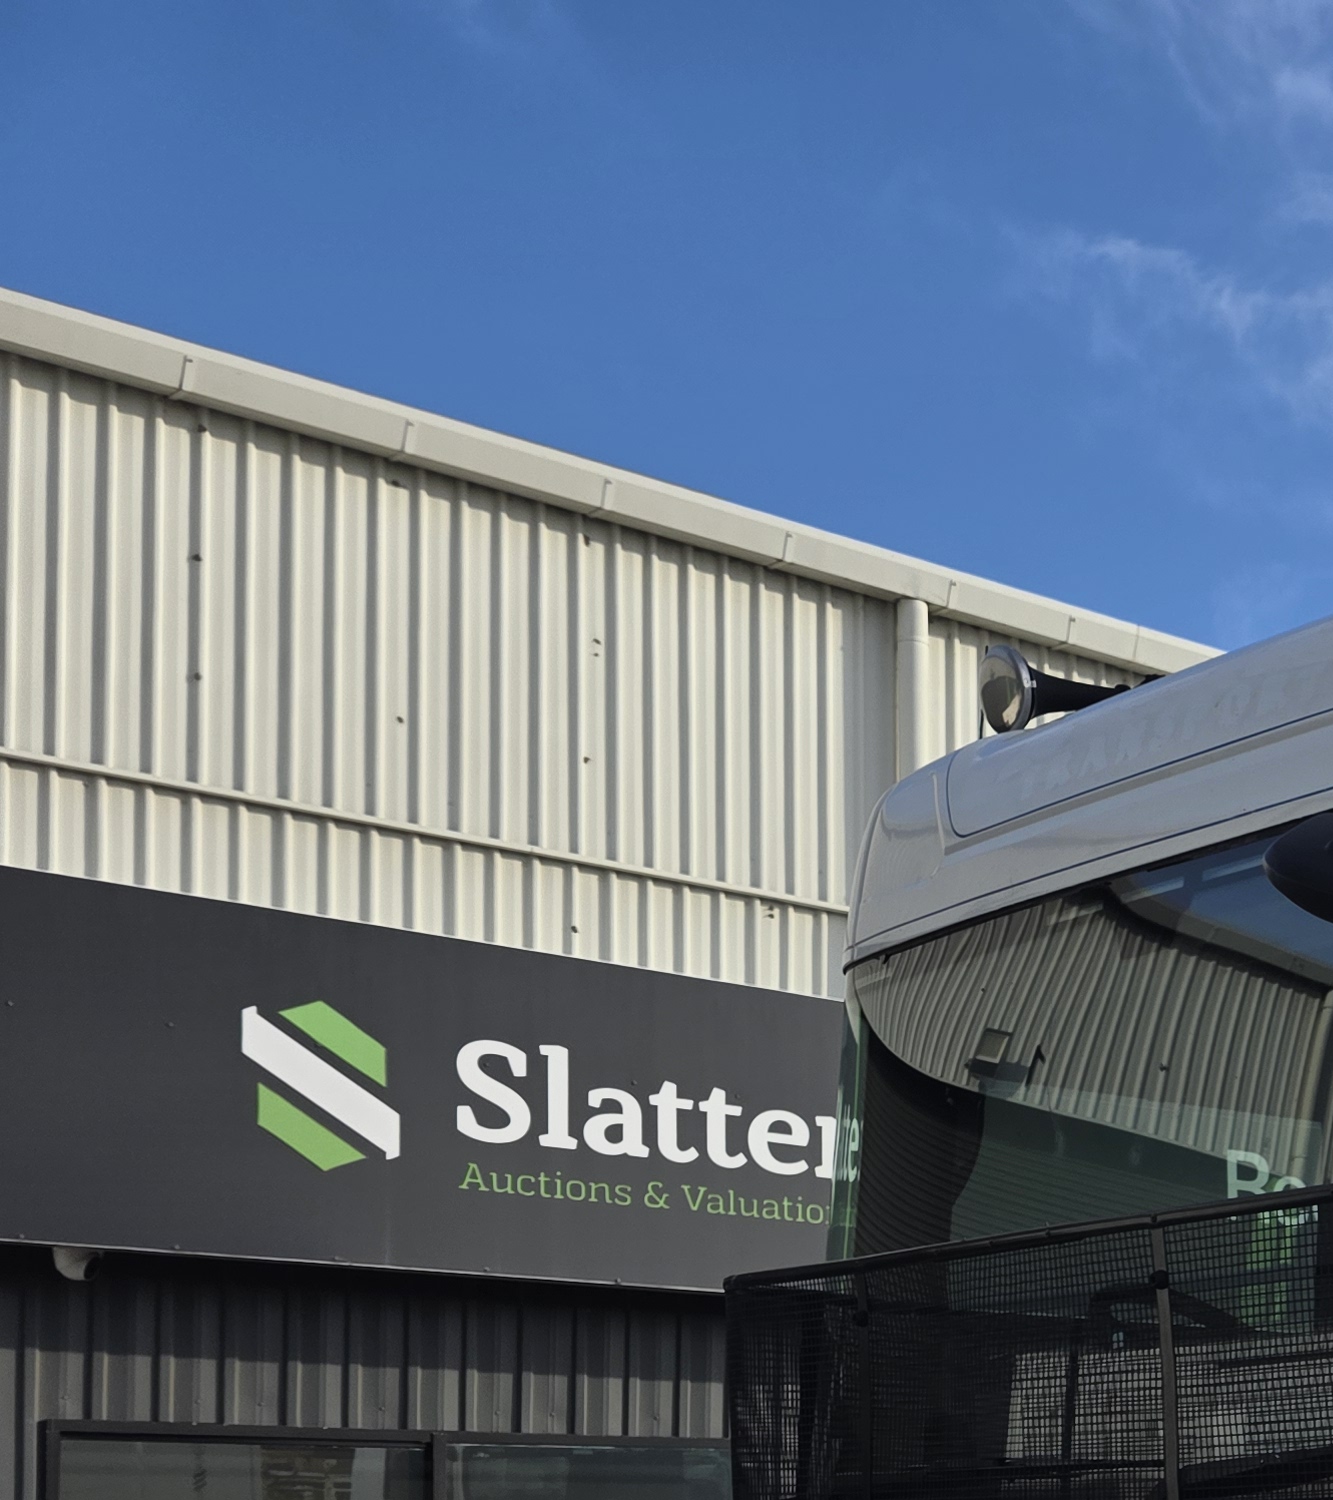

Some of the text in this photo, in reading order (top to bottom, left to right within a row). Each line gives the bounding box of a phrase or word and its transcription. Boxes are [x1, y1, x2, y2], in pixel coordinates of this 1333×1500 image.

[456, 1039, 837, 1179] Slatter
[458, 1162, 831, 1225] Auctions & Valuatio
